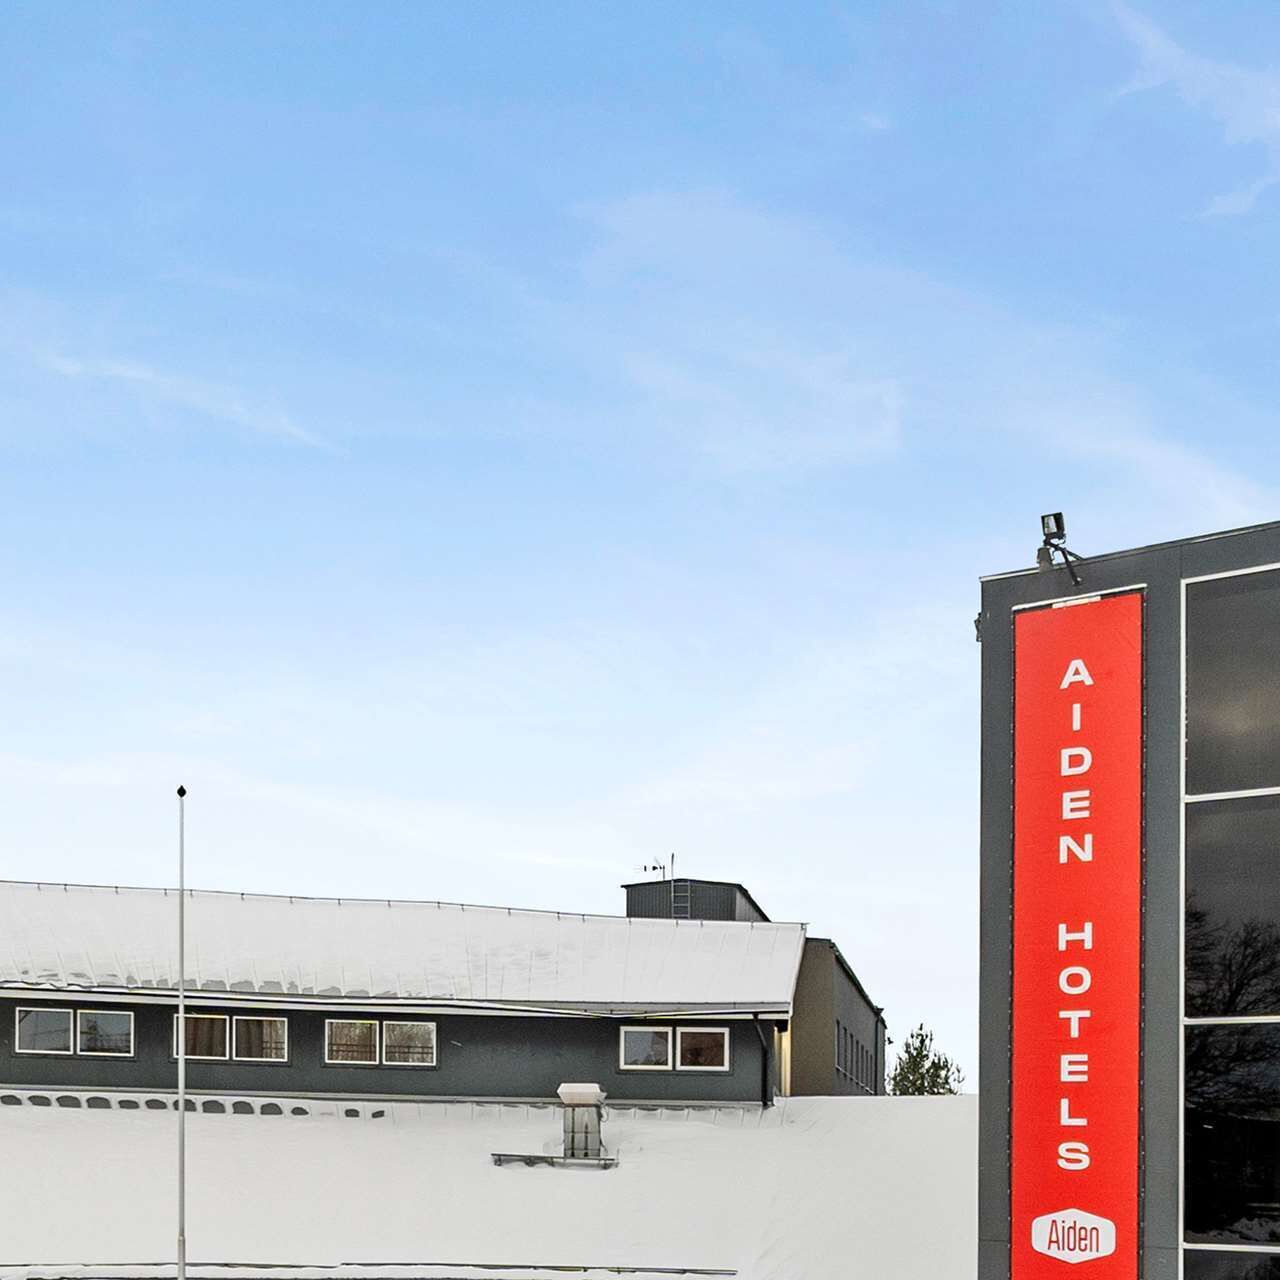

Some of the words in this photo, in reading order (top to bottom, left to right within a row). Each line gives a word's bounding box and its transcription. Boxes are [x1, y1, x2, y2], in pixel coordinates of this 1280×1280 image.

[1059, 658, 1095, 864] AIDEN
[1056, 921, 1093, 1171] HOTELS
[1047, 1219, 1099, 1252] Aiden
